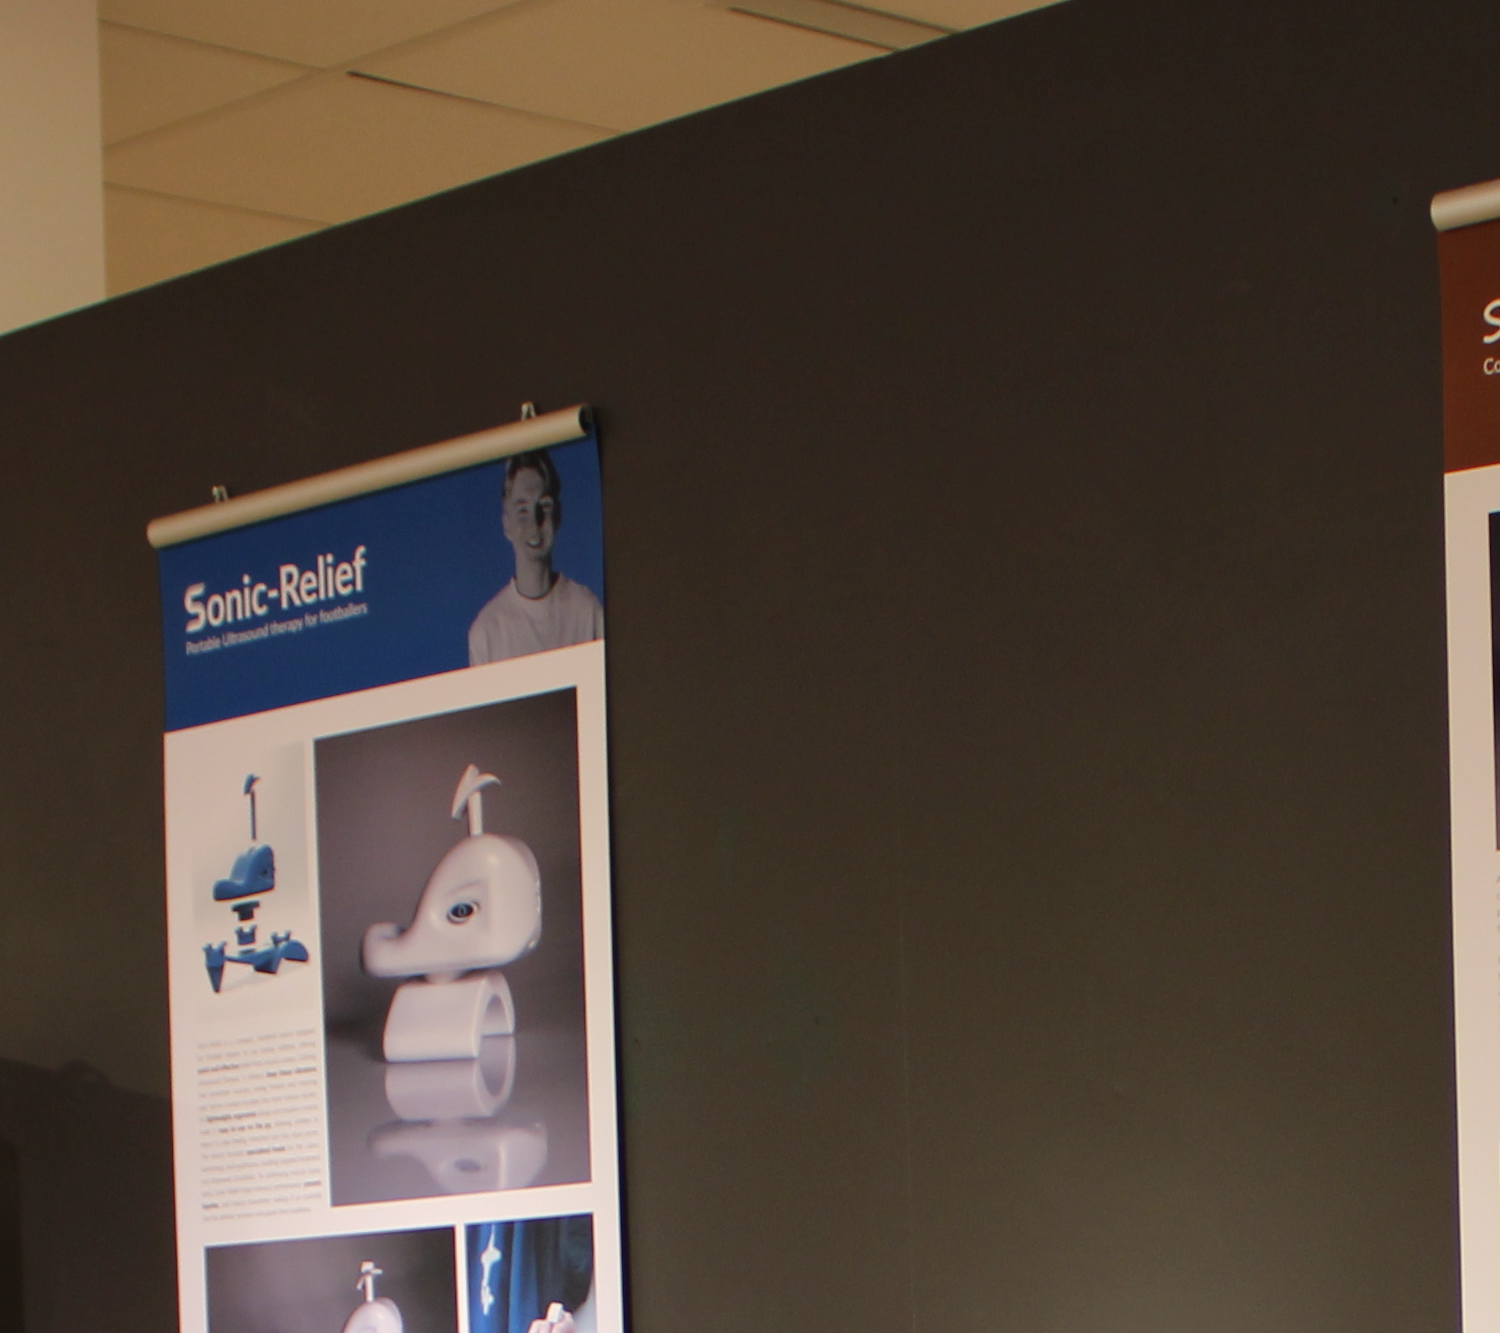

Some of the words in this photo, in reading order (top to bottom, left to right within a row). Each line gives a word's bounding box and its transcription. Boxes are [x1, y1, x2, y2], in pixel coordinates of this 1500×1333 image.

[184, 545, 367, 634] Sonic-Relief
[270, 615, 303, 635] therapy
[304, 611, 318, 628] for
[319, 601, 369, 625] footballers
